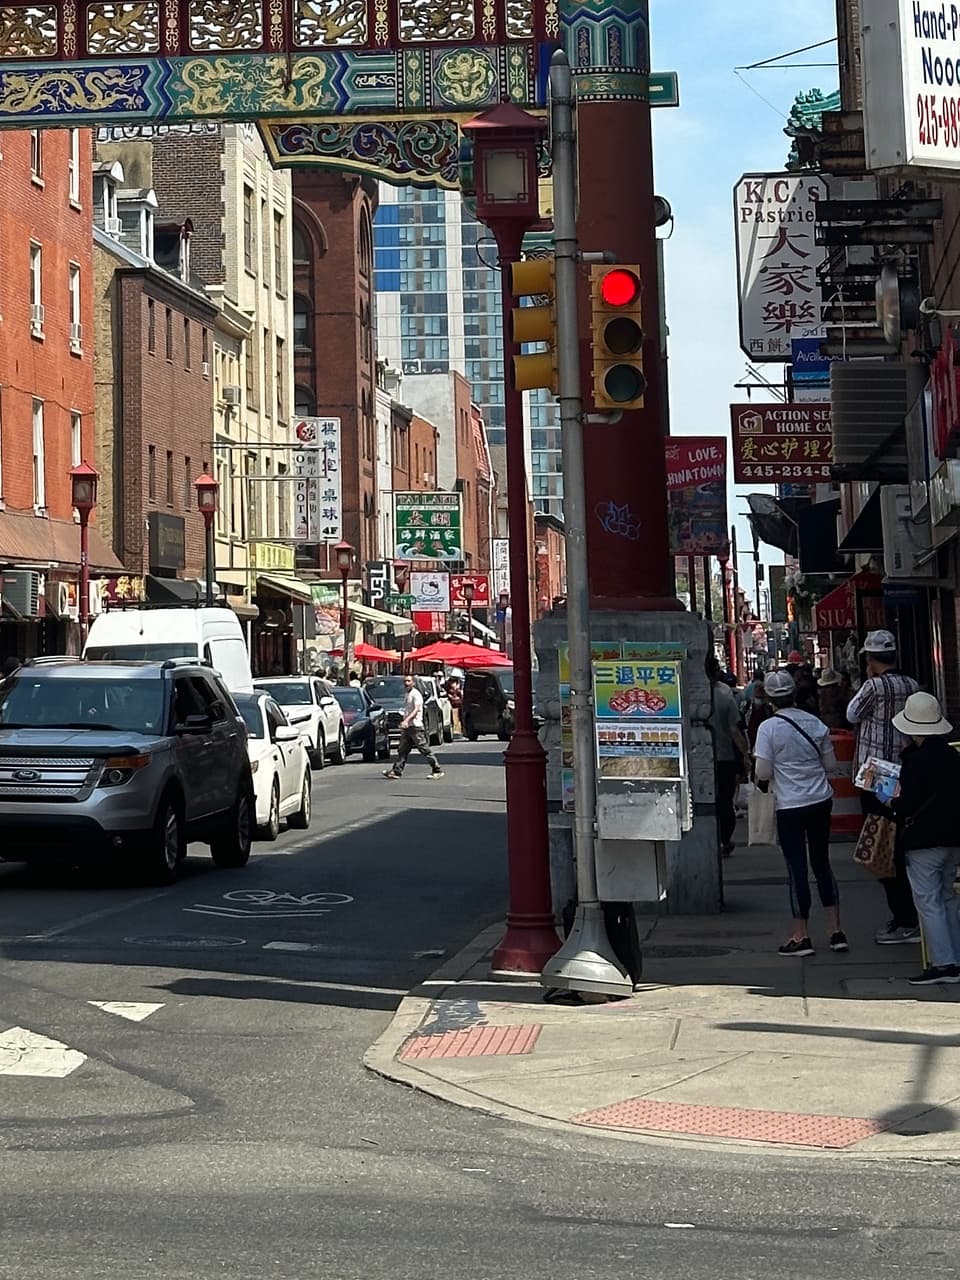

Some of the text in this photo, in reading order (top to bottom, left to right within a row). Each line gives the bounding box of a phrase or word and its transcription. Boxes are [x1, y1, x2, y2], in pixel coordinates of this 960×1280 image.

[912, 0, 960, 41] Hand-P
[744, 180, 820, 203] K.C.'s
[741, 207, 815, 223] Pastrie
[757, 226, 816, 334] 大家樂
[765, 411, 809, 421] ACTION
[776, 422, 832, 433] HOME CA
[688, 446, 722, 463] LOVE,
[741, 438, 834, 461] 爱心护理公
[742, 465, 831, 477] 445-234-8
[397, 495, 458, 504] TAI LAKE
[819, 609, 845, 626] SIU
[595, 666, 677, 686] 三退平安
